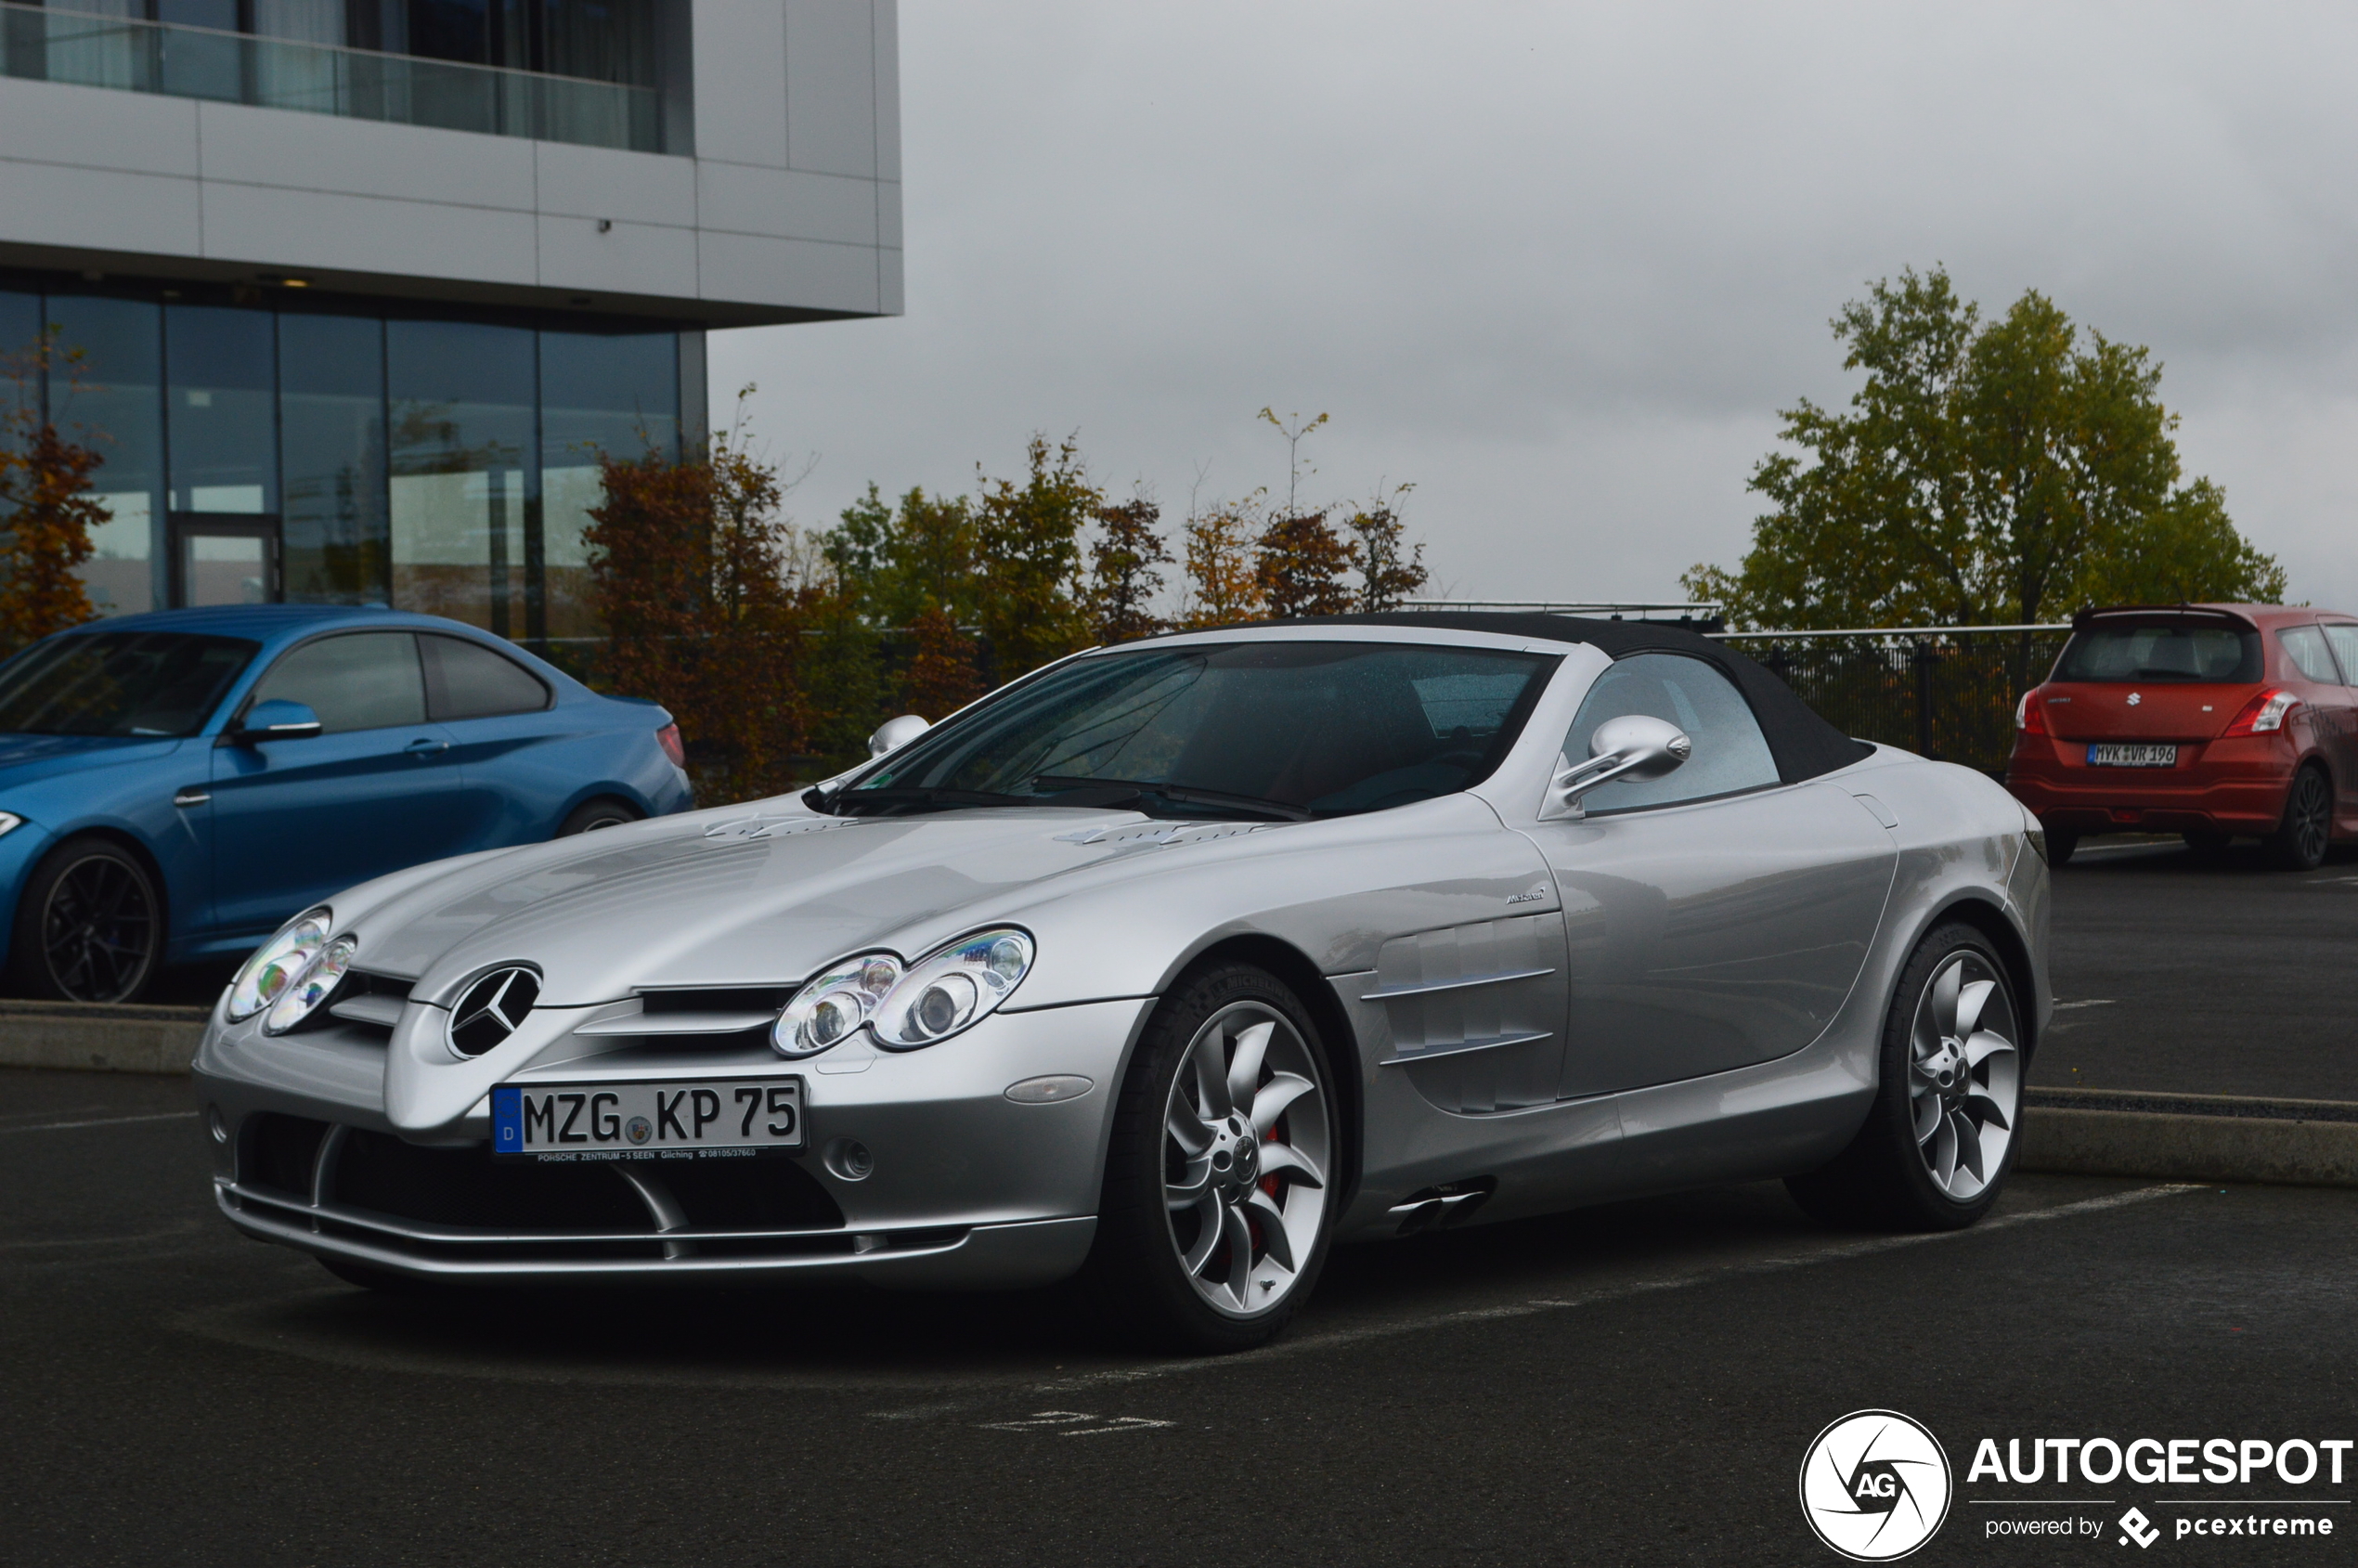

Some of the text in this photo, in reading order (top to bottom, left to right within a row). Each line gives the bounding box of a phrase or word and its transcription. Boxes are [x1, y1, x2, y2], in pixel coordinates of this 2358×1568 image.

[2096, 745, 2174, 761] MYK VR 196
[1226, 976, 1285, 1001] MICHELIN
[524, 1086, 796, 1144] MZG KP 75
[503, 1127, 514, 1141] D
[538, 1153, 577, 1162] PORSCHE
[632, 1151, 654, 1160] SEEN
[661, 1150, 693, 1160] Gilching
